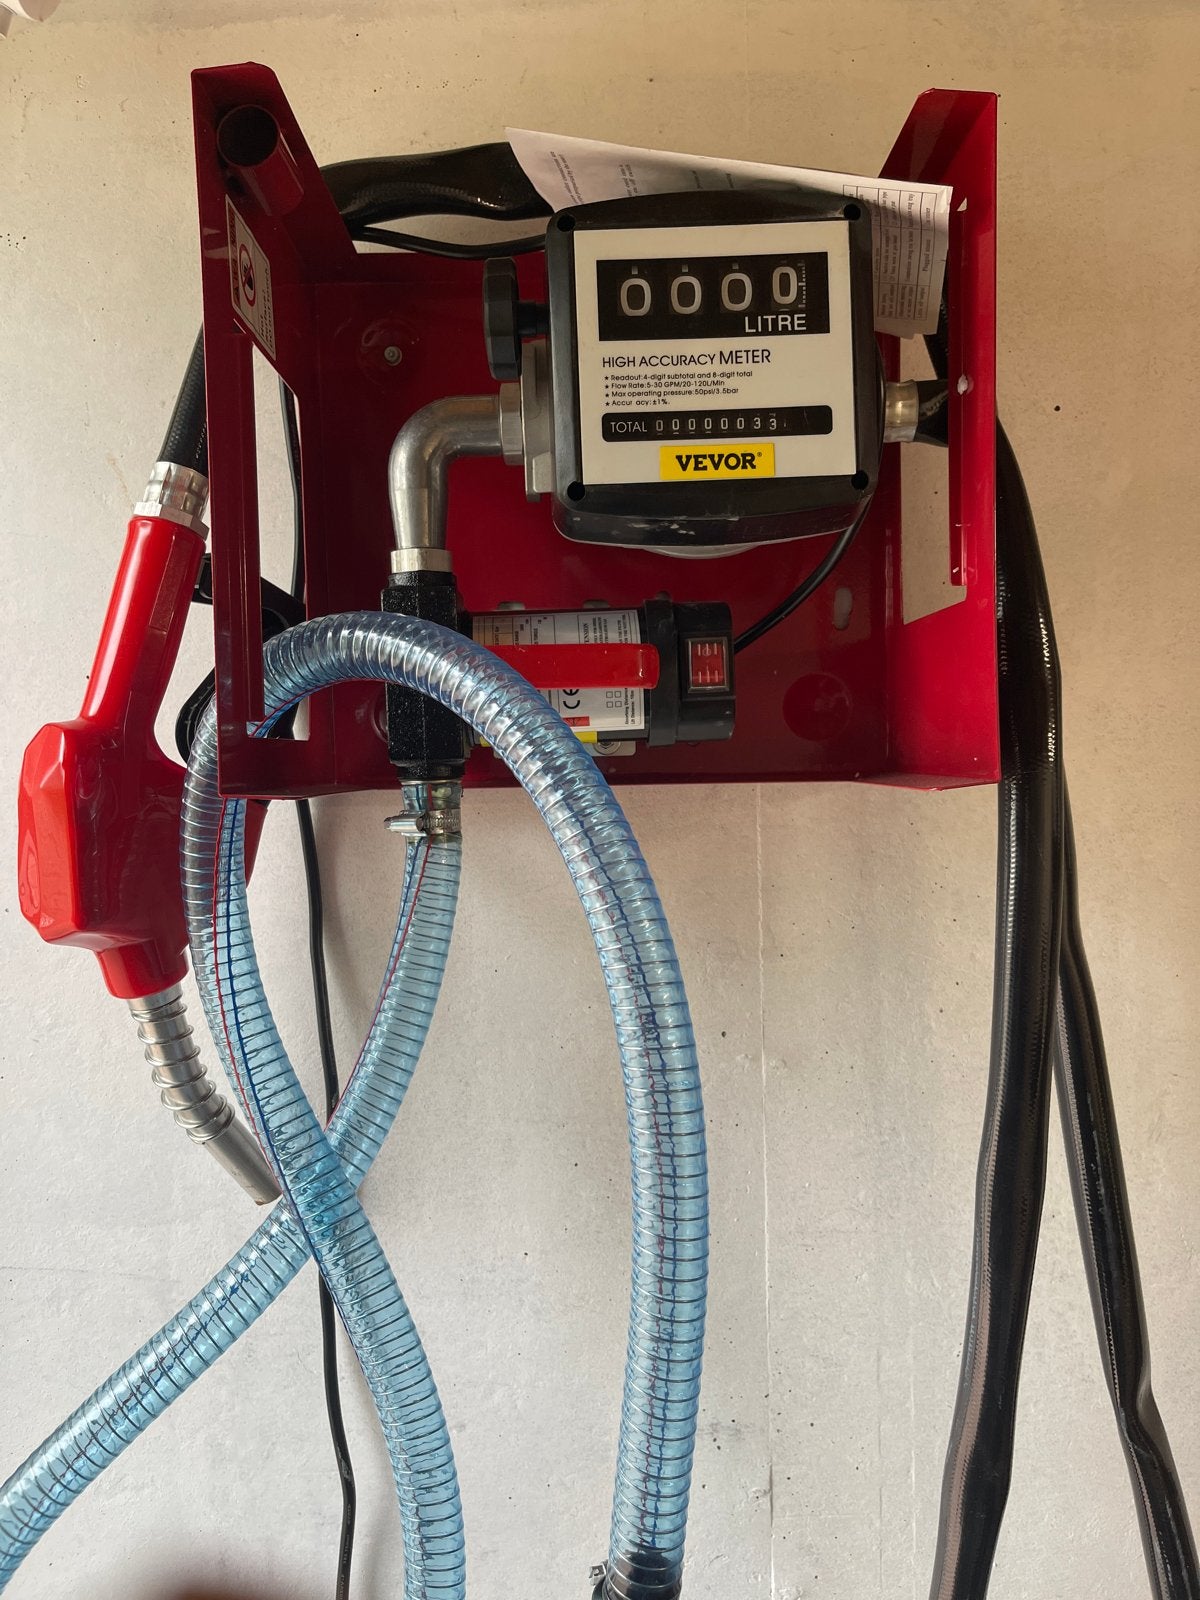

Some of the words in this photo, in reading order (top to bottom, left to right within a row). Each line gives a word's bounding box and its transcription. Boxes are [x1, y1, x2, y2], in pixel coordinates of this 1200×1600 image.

[744, 313, 807, 333] LITRE
[602, 356, 636, 368] HIGH
[638, 353, 716, 367] ACCURACY
[719, 348, 771, 365] METER
[712, 371, 735, 379] 8-digit
[627, 389, 662, 398] operating
[610, 421, 648, 433] TOTAL
